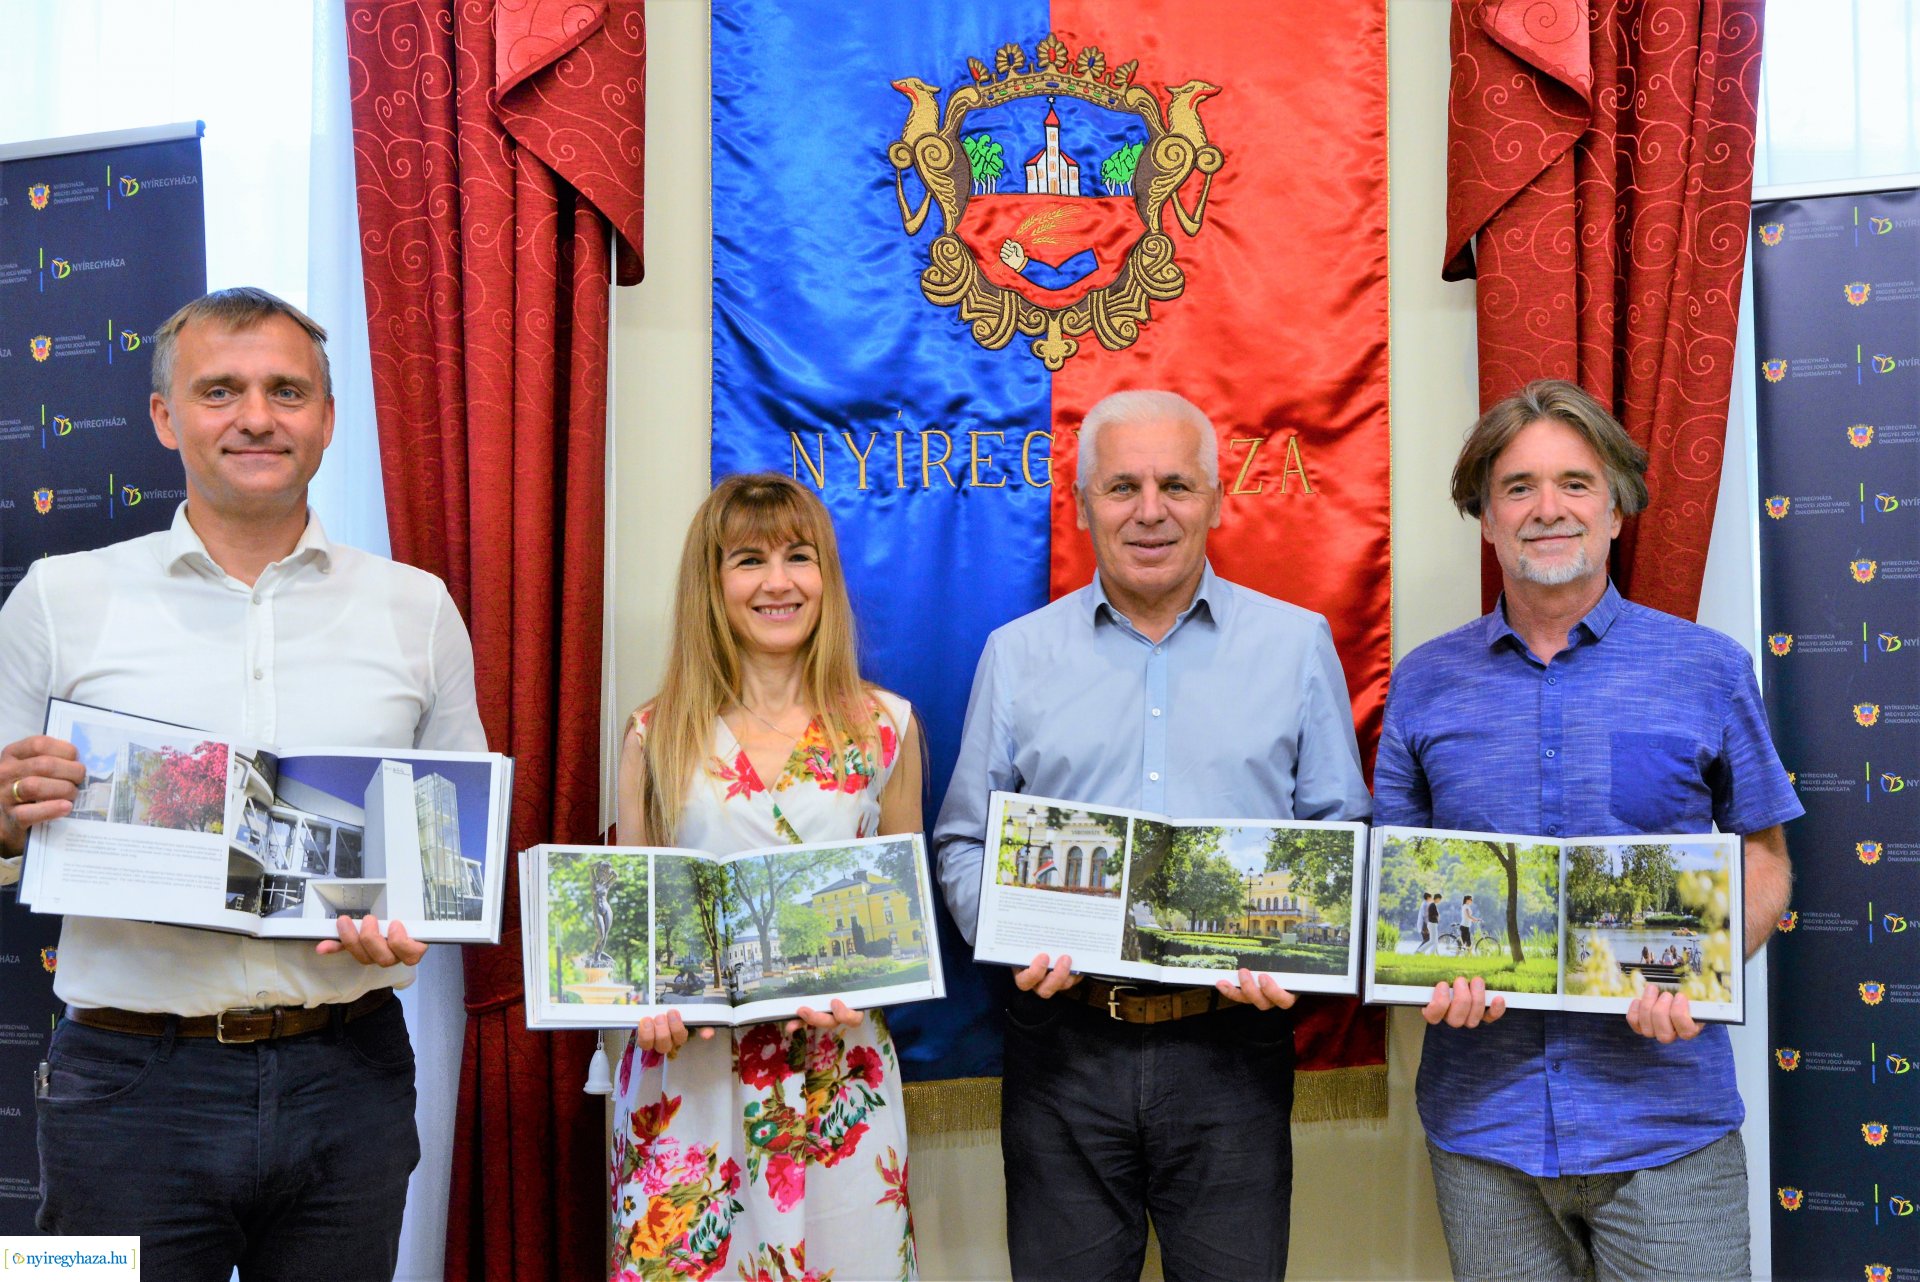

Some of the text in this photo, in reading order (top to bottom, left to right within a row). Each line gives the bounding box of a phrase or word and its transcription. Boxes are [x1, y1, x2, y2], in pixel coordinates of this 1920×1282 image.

[141, 175, 198, 189] NYÍREGYHÁZA
[72, 258, 126, 272] NYÍREGYHÁZA
[74, 416, 126, 430] NYÍREGYHÁZA
[790, 410, 1317, 494] NYÍREGZA
